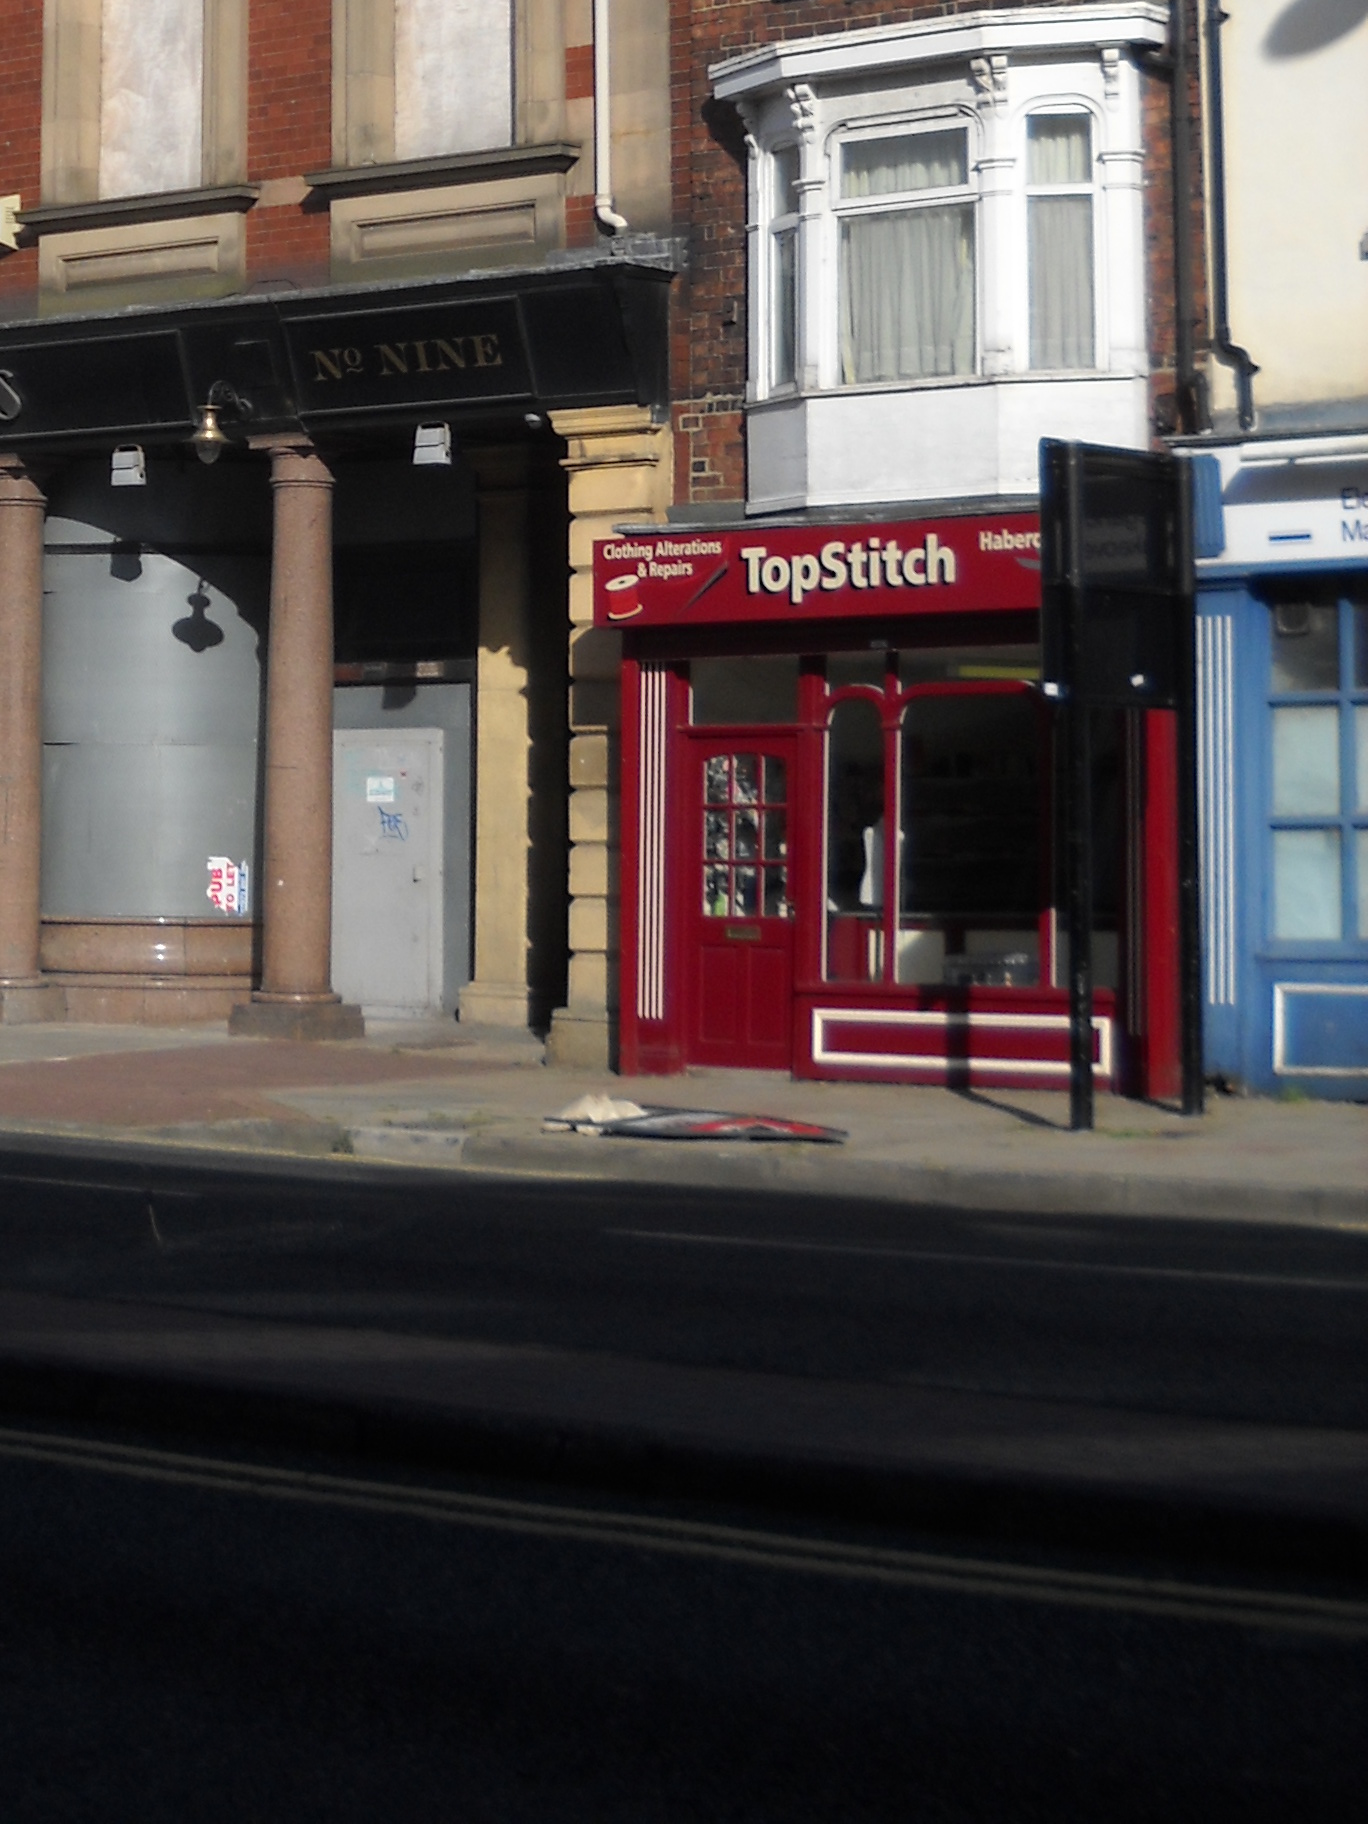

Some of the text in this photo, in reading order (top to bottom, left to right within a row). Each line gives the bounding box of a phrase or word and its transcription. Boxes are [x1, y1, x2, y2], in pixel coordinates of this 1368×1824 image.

[374, 334, 502, 375] NINE
[603, 538, 722, 563] Clothing Alterations
[637, 559, 694, 580] & Repairs
[741, 533, 957, 605] TopStitch
[211, 868, 222, 906] PUB
